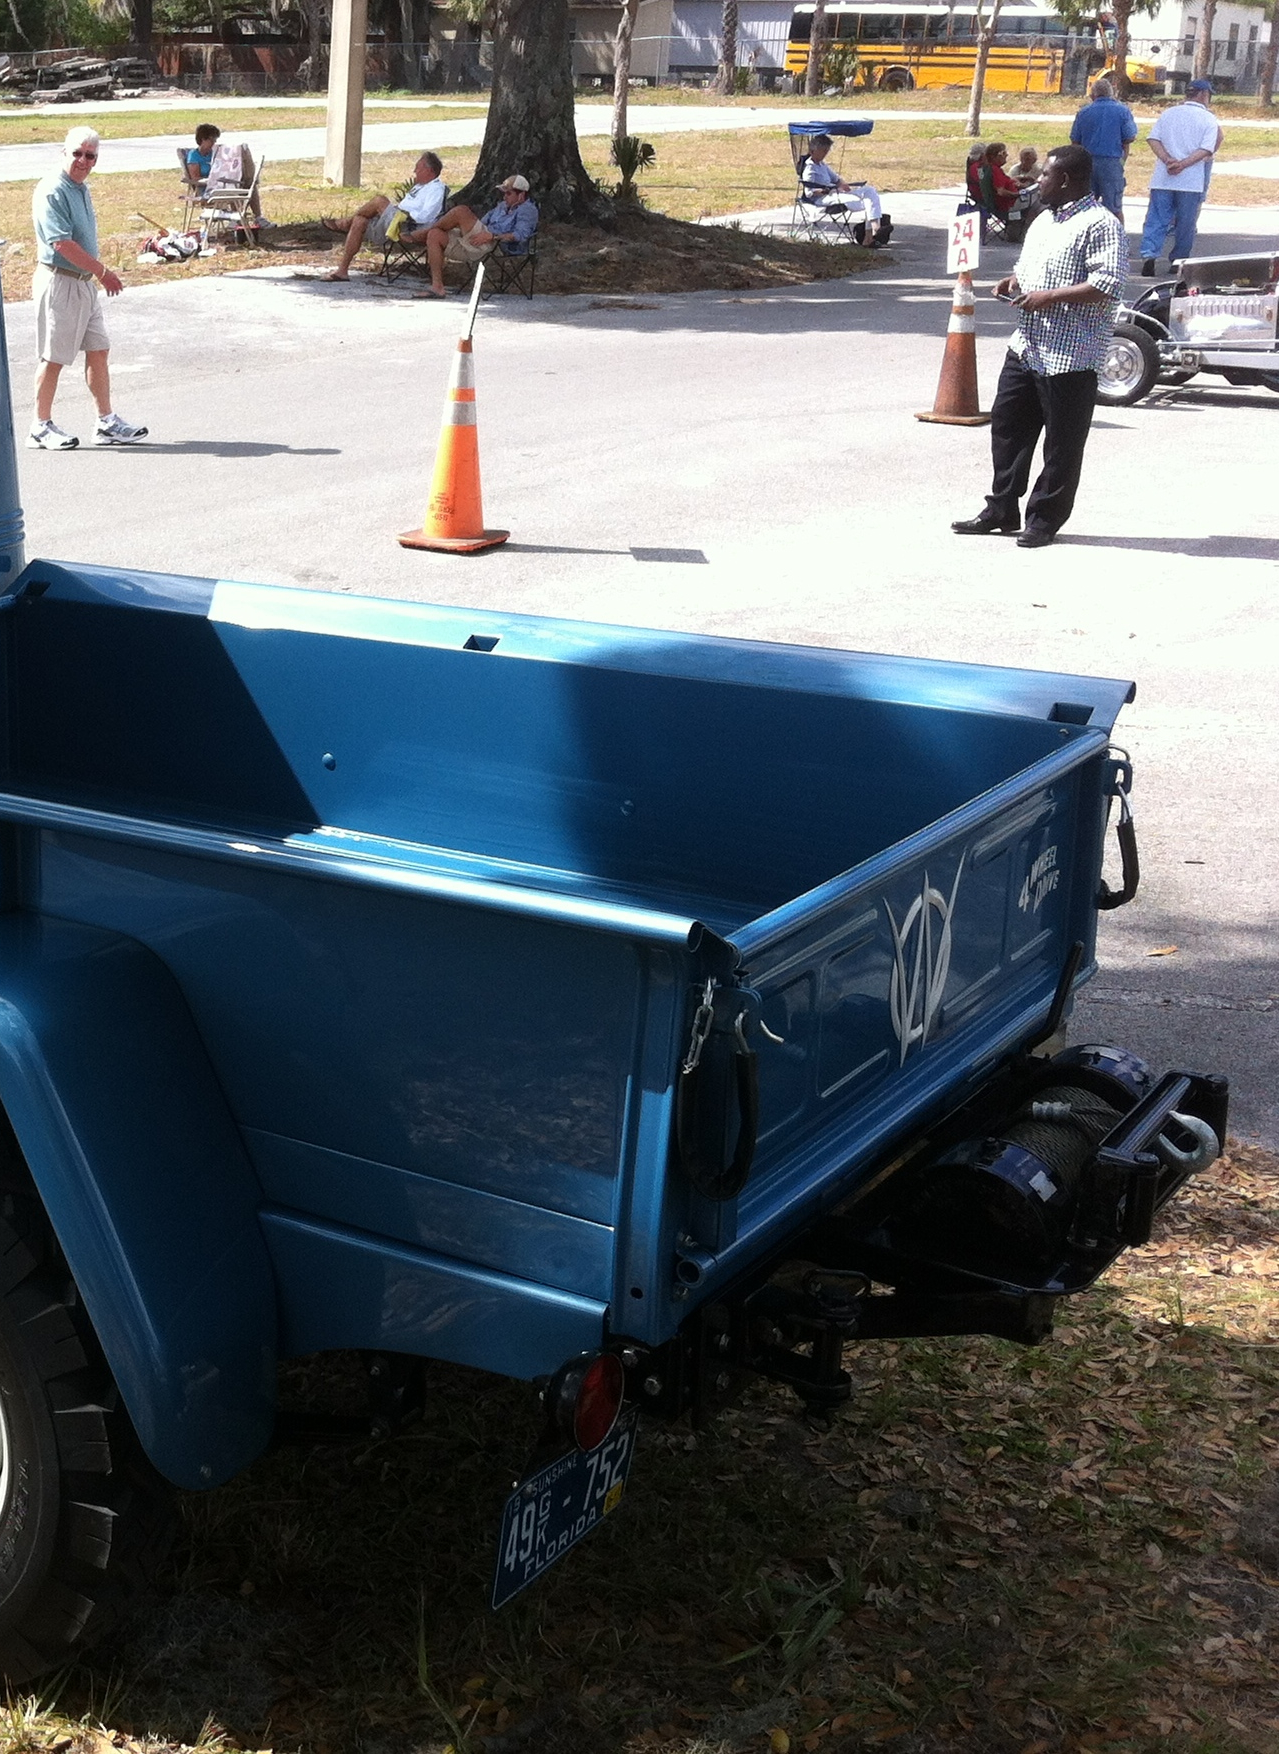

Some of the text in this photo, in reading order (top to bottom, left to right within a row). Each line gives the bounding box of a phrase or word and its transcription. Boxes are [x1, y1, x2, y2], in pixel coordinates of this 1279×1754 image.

[952, 218, 974, 246] 24
[957, 247, 968, 266] A
[1030, 845, 1057, 889] WHEEL
[1018, 875, 1030, 913] 4
[1033, 869, 1060, 914] DRIVE
[532, 1453, 578, 1498] SUNSHINE
[524, 1506, 597, 1580] FLORIDA
